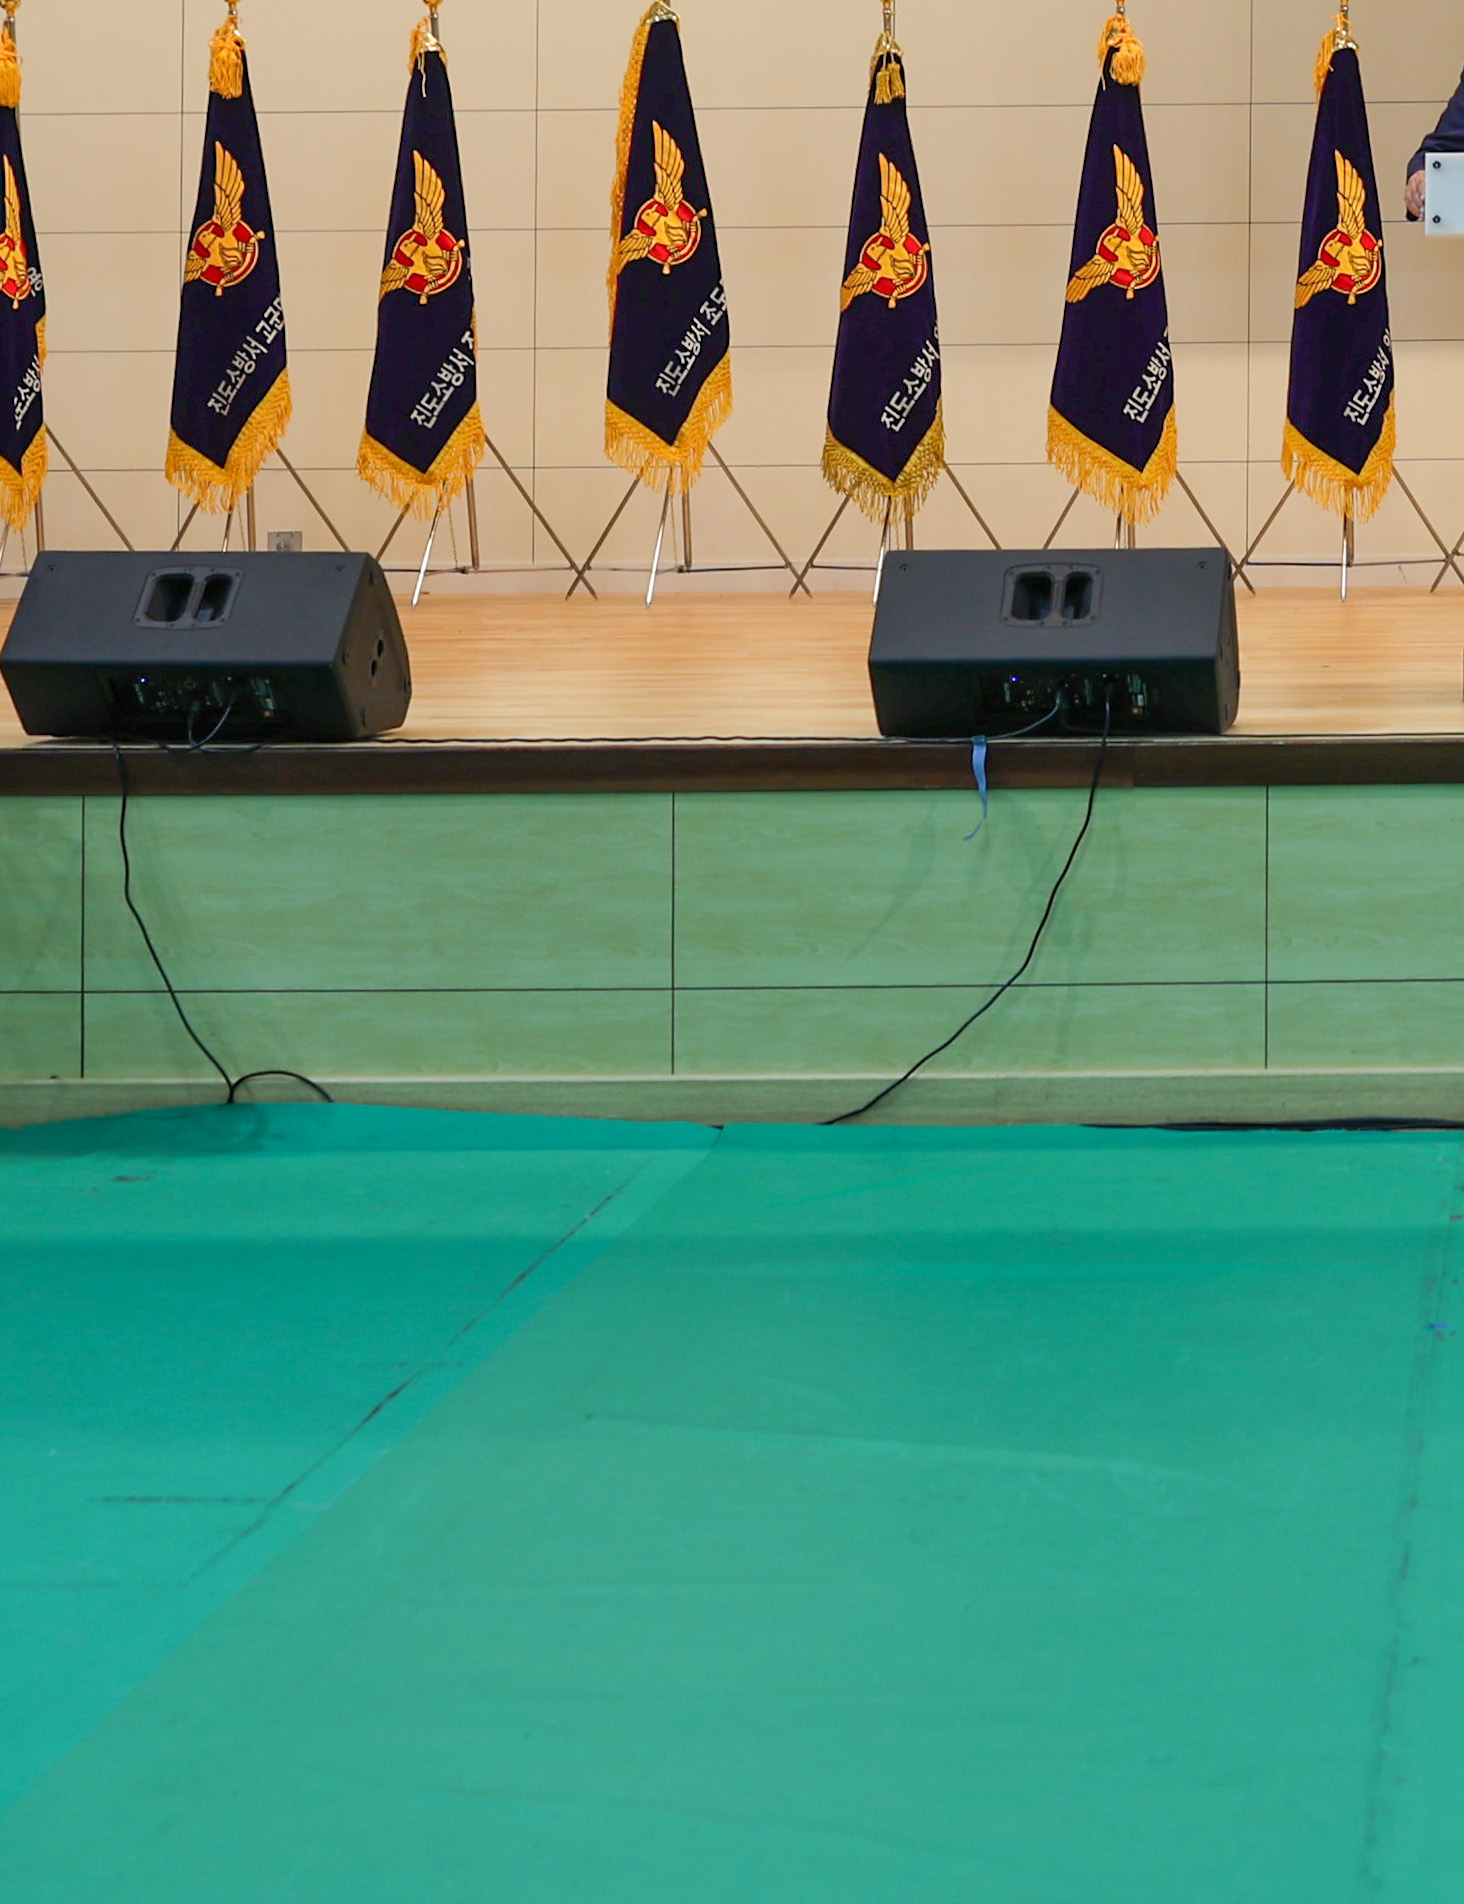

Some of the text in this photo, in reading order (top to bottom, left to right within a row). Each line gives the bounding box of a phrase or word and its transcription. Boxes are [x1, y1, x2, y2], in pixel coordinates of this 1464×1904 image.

[207, 295, 285, 417] 진도소방서 고군
[409, 348, 475, 429] 진도소방서
[655, 317, 712, 397] 진도소방서
[881, 339, 940, 432] 진도소방서
[1123, 341, 1170, 424] 진도소방서
[1343, 346, 1389, 426] 진도소방서
